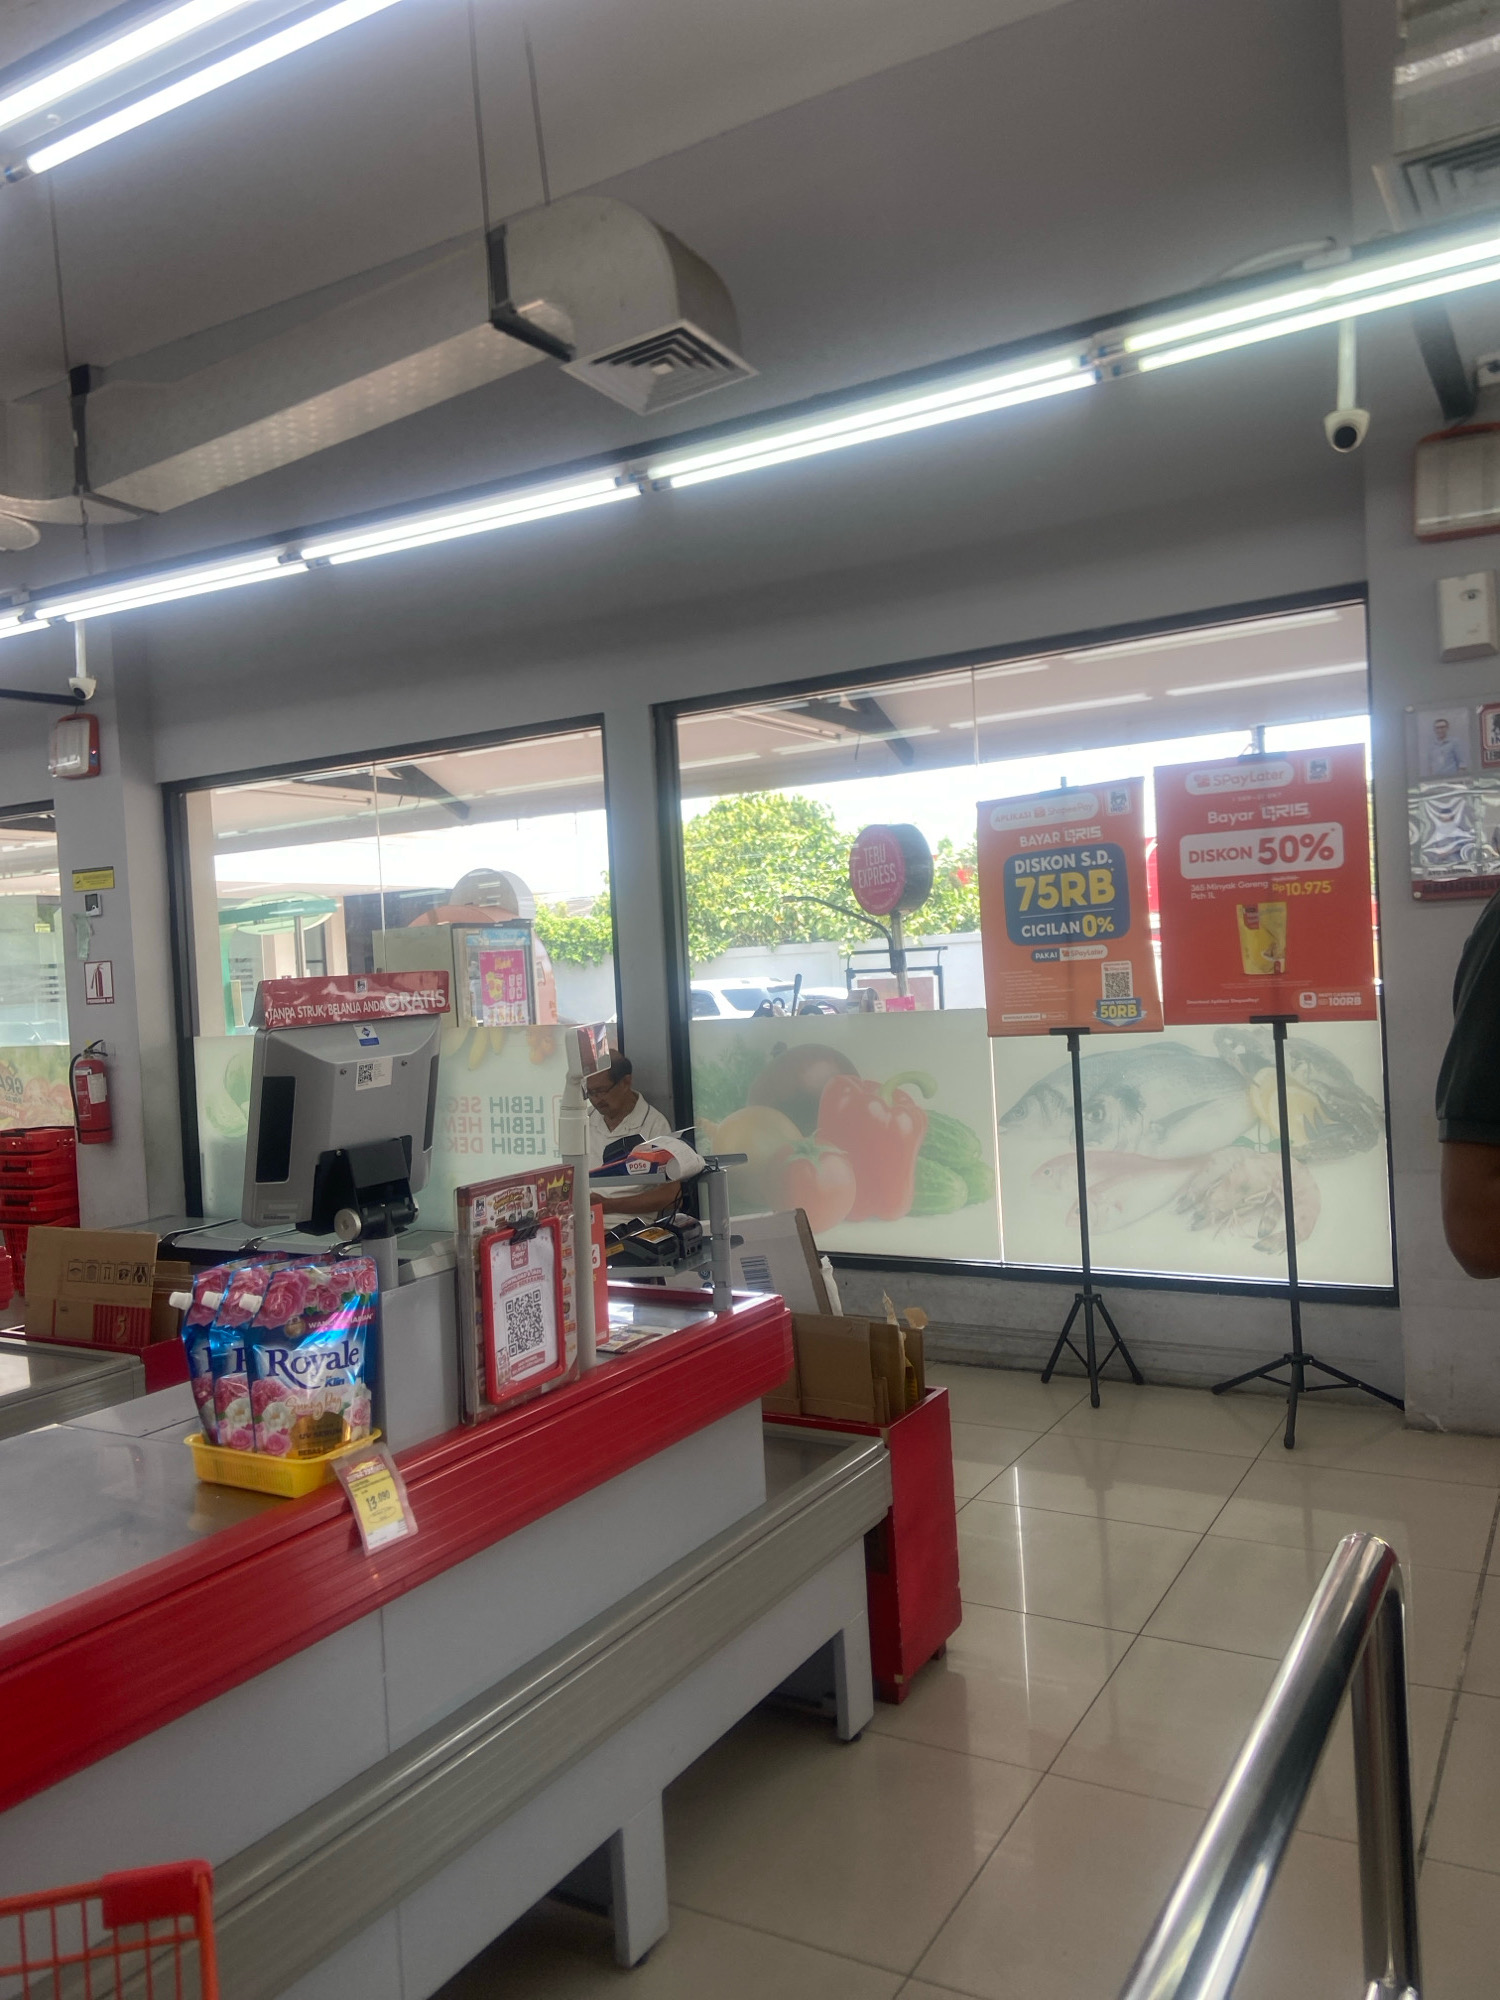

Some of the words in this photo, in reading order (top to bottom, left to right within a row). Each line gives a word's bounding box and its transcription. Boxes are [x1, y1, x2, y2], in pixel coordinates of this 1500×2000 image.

[1212, 769, 1284, 787] SPayLater
[995, 811, 1031, 823] APLIKASI
[1047, 802, 1094, 818] ShopeePay
[1207, 810, 1254, 826] Bayar
[1261, 803, 1310, 821] QRIS
[1019, 832, 1060, 848] BAYAR
[1064, 826, 1102, 843] QRIS
[863, 842, 886, 867] TEBU
[1014, 853, 1076, 874] DISKON
[1080, 850, 1113, 867] S.D.
[1188, 846, 1253, 864] DISKON
[857, 862, 897, 889] EXPRESS
[1190, 883, 1205, 892] 365
[1207, 881, 1236, 892] Minyak
[1238, 880, 1269, 888] Goreng
[1015, 868, 1116, 912] 75RB
[1190, 892, 1206, 900] Pch
[1021, 920, 1081, 938] CICILAN
[1081, 914, 1115, 937] 0%
[1035, 952, 1058, 960] PAKAI
[1069, 949, 1104, 958] SPayLater
[268, 1007, 297, 1021] TANPA
[297, 1005, 327, 1018] STRUK,
[327, 1001, 362, 1016] BELANJA
[362, 1000, 386, 1012] ANDA
[385, 989, 446, 1012] GRATIS
[1100, 1004, 1137, 1018] 50RB
[1327, 996, 1362, 1006] 100RB
[265, 1340, 359, 1389] Royale
[285, 1396, 323, 1420] Sunny
